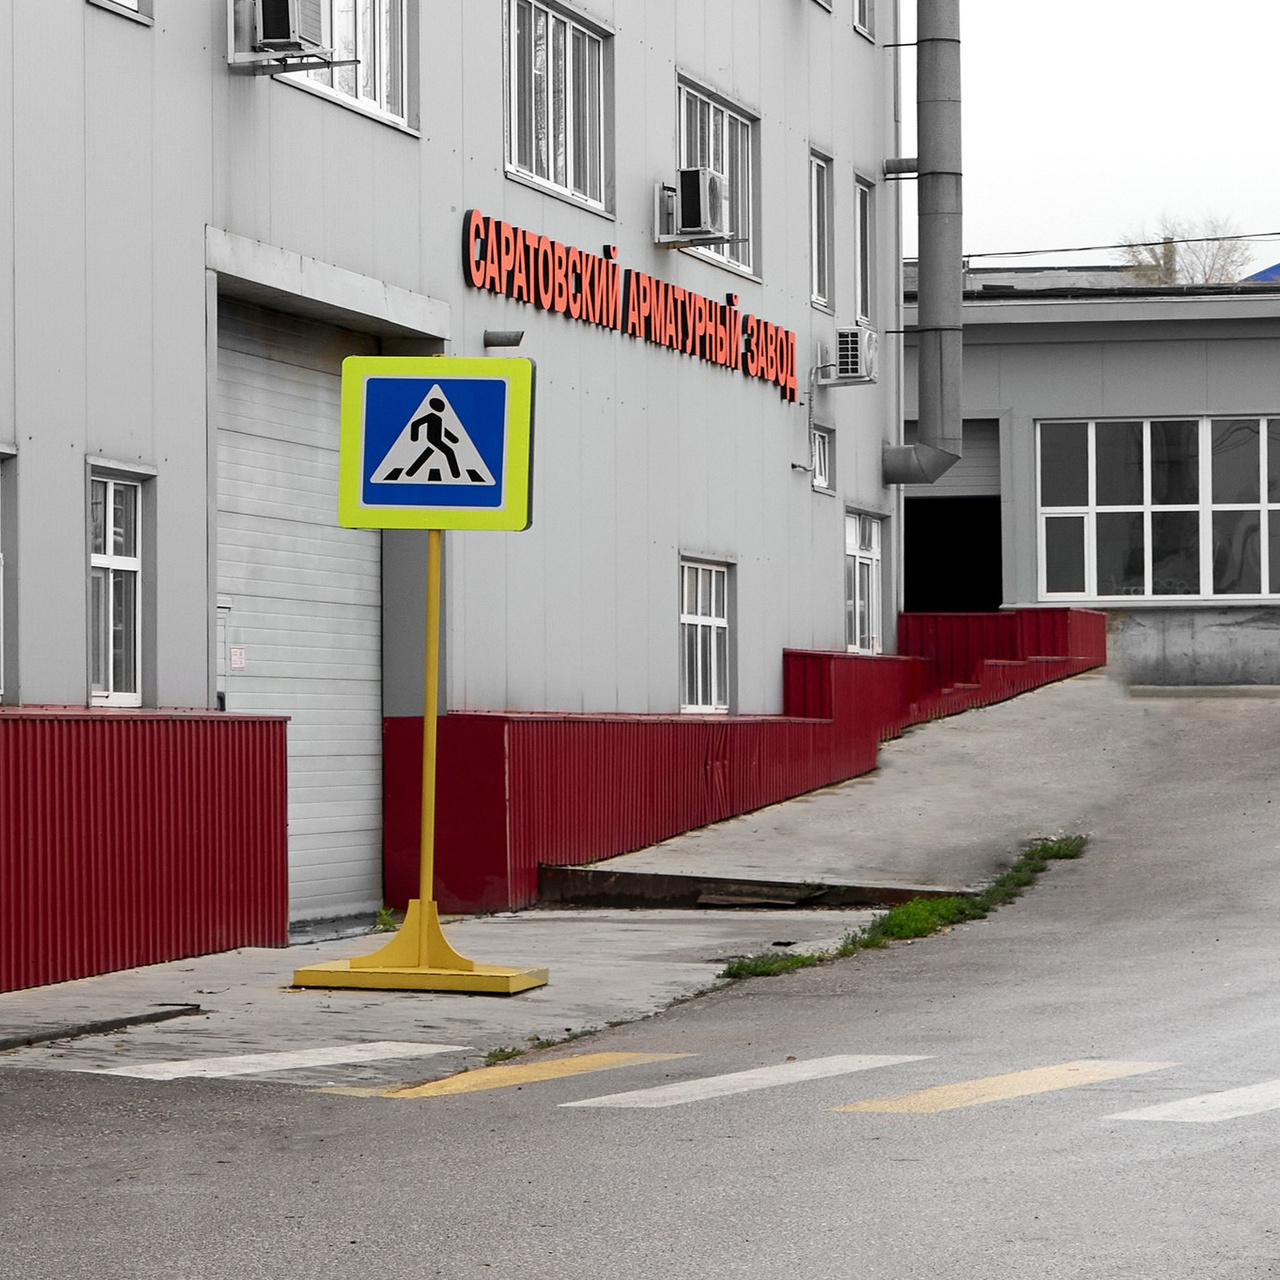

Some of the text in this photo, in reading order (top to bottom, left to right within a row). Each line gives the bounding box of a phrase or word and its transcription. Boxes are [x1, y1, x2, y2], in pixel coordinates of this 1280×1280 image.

[465, 208, 798, 403] САРАТОВСКИЙ АРМАТУРНЫЙ ЗАВОД
